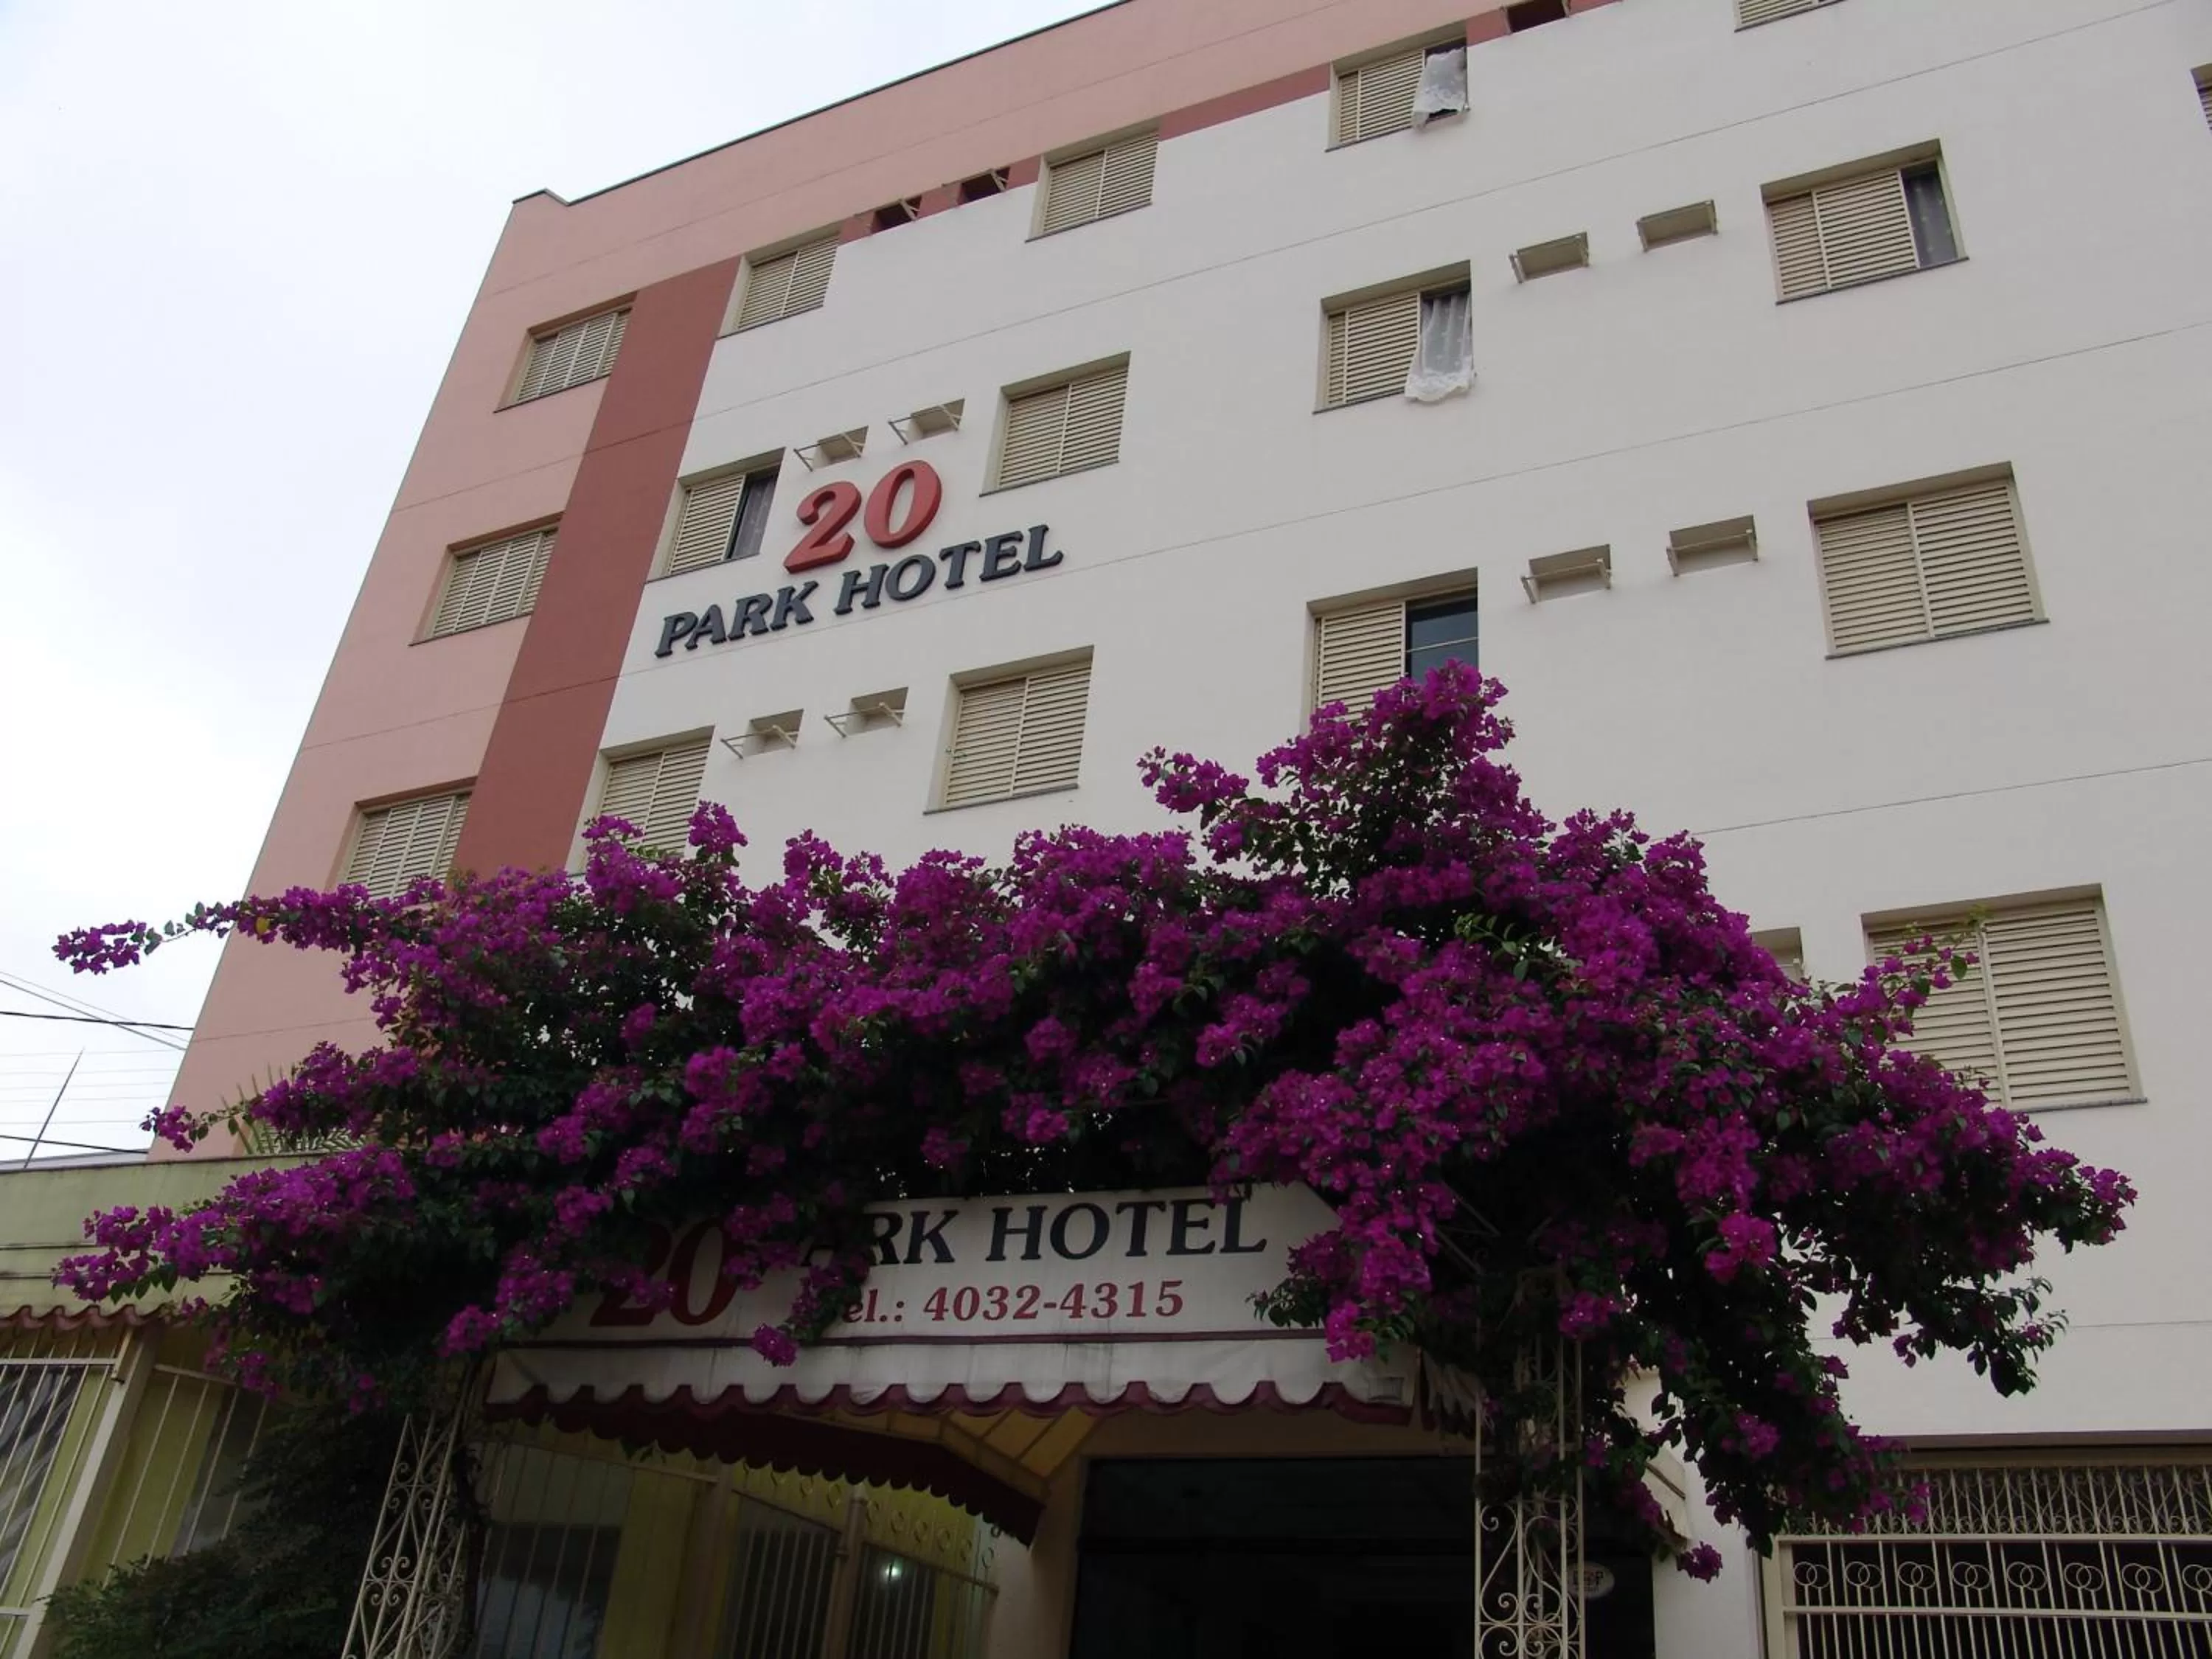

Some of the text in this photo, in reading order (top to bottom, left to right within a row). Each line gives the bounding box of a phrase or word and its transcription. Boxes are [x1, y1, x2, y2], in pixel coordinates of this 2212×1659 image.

[783, 459, 942, 574] 20
[655, 524, 1063, 658] PARK HOTEL
[986, 1196, 1267, 1262] HOTEL
[923, 1280, 1183, 1321] 4032-4315
